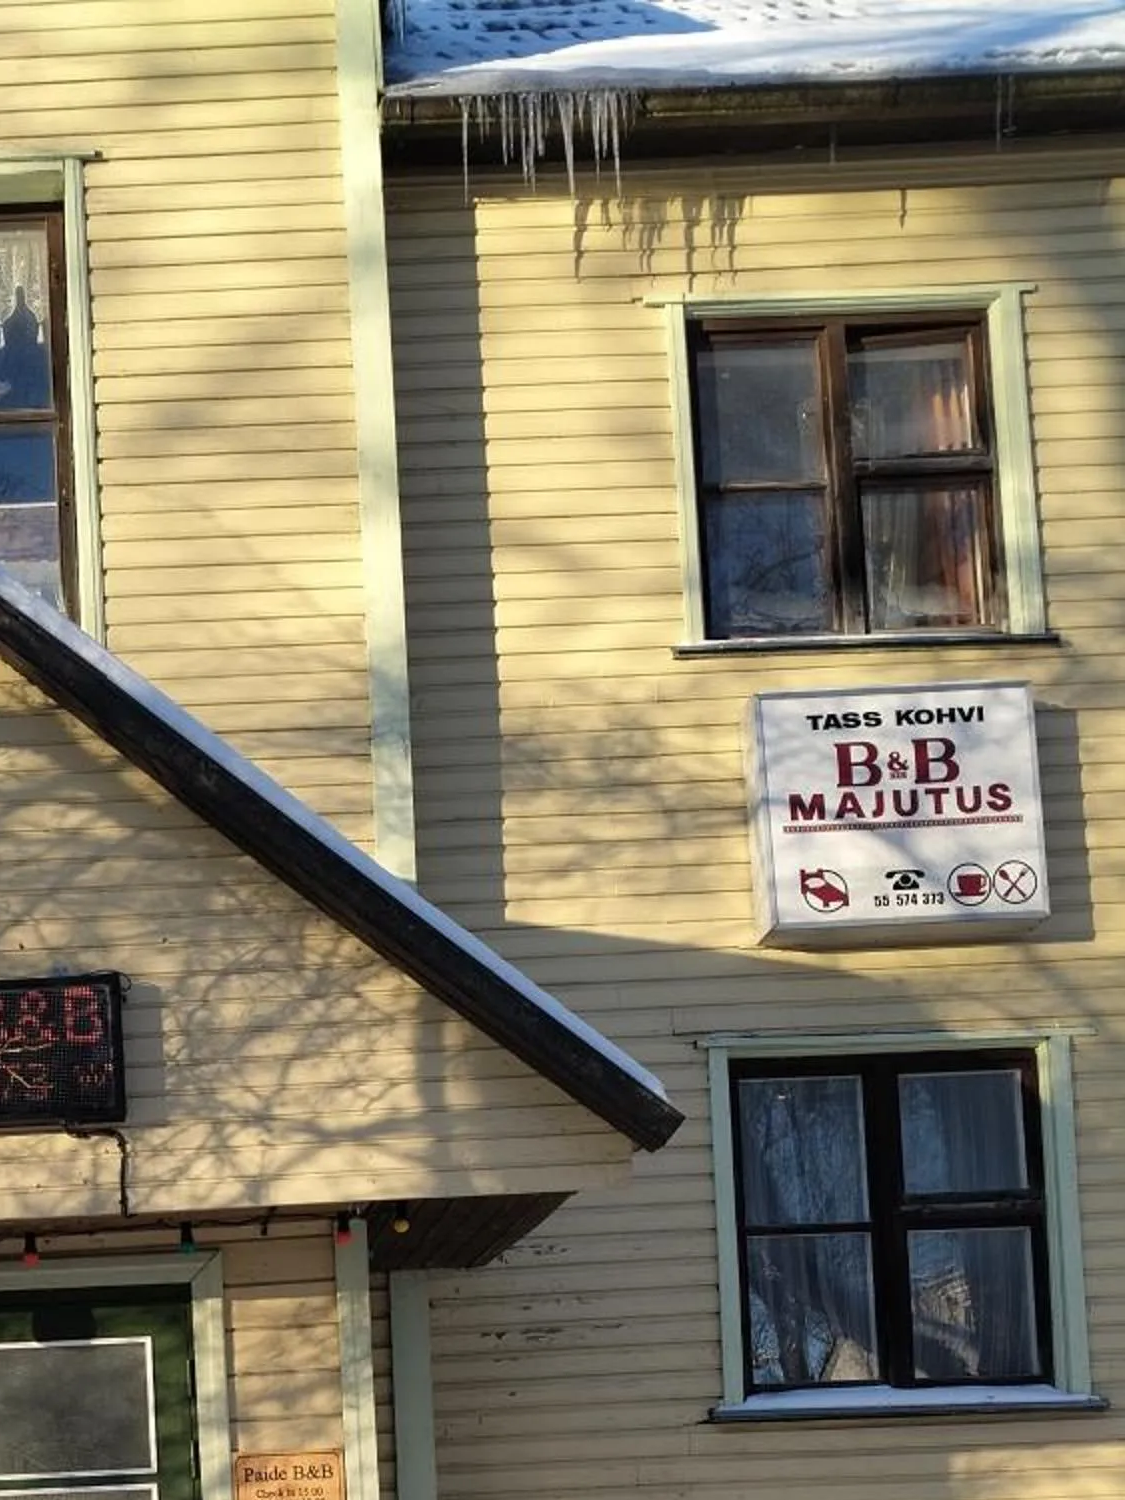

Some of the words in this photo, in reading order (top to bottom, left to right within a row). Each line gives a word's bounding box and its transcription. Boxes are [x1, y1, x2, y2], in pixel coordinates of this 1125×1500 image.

[806, 711, 882, 731] TASS
[895, 706, 985, 727] KOHVI
[833, 737, 961, 788] B&B
[788, 783, 1013, 821] MAJUTUS
[874, 894, 890, 907] 55
[896, 893, 918, 906] 574
[244, 1466, 287, 1483] Paide
[293, 1463, 334, 1480] B&B
